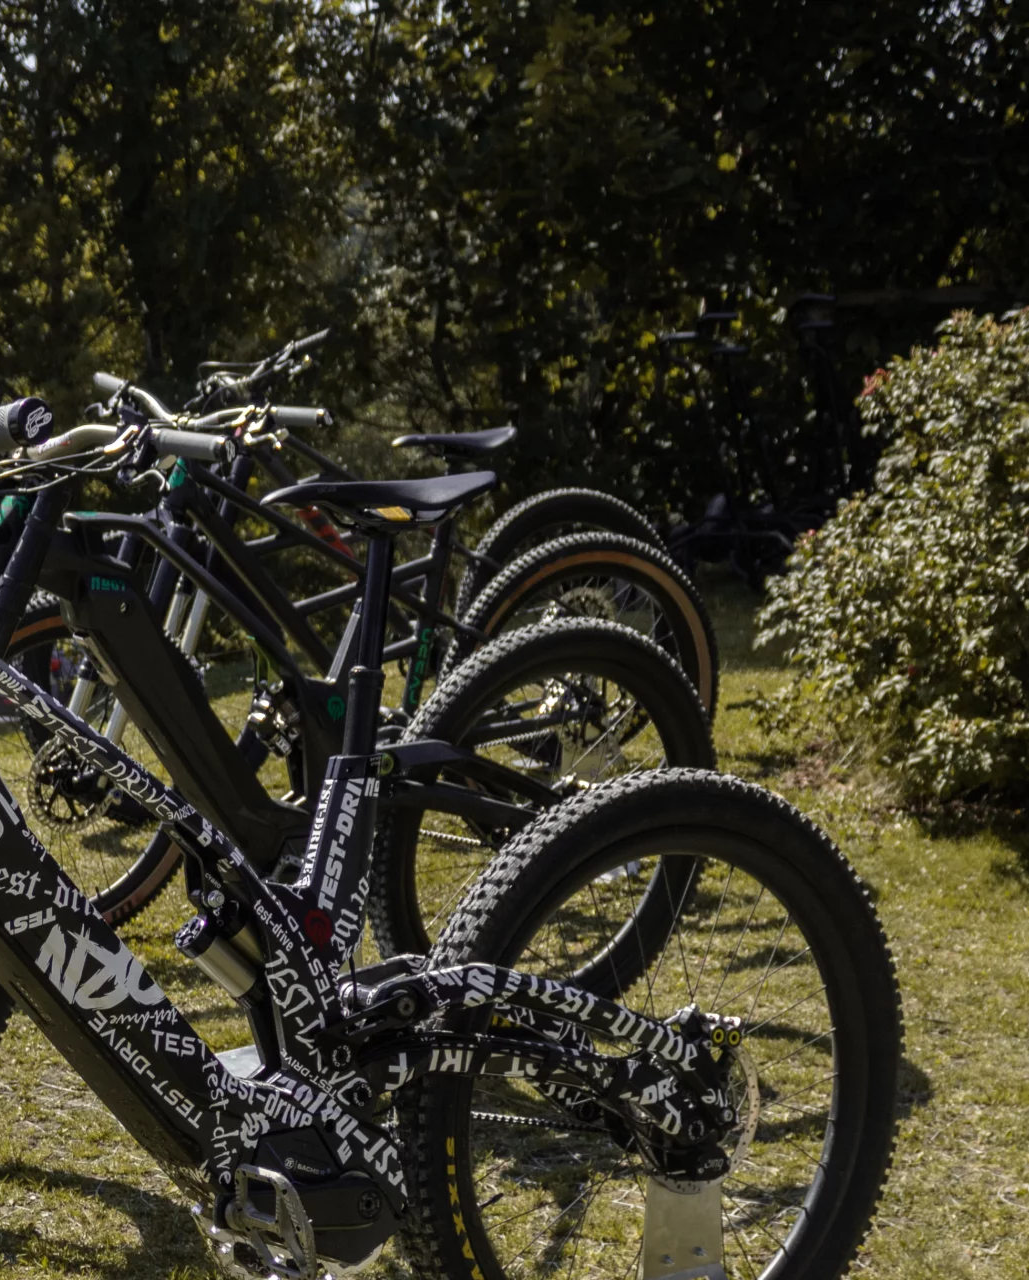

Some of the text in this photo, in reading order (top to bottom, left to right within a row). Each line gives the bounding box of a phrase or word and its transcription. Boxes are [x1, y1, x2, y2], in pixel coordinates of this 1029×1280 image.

[253, 900, 294, 952] test-drive
[88, 1010, 203, 1129] TEST-DRIVE
[280, 1047, 339, 1100] TEST-DRIVE
[202, 1058, 240, 1185] test-drive
